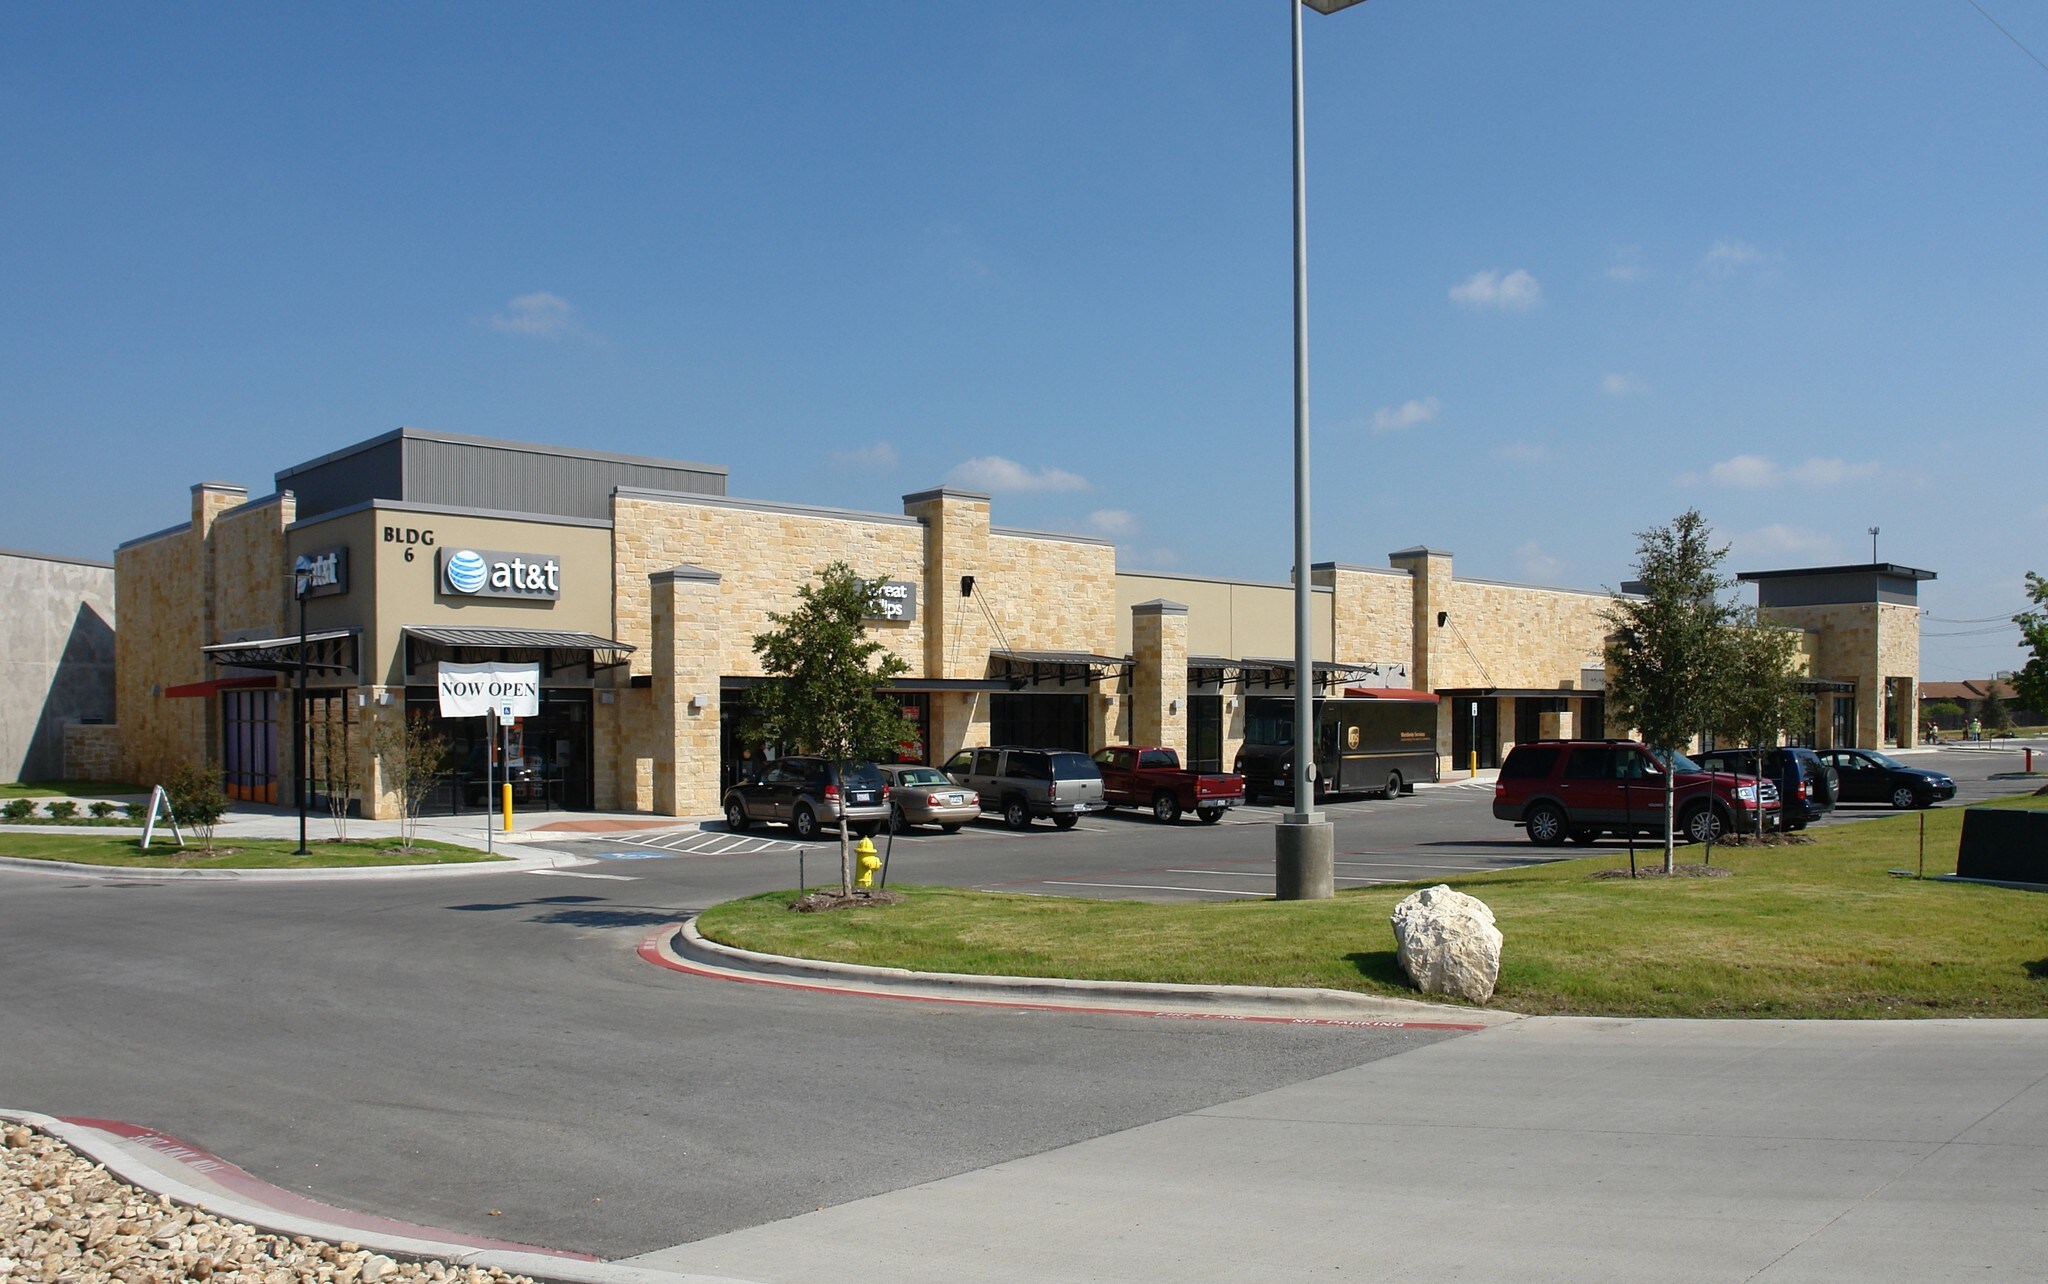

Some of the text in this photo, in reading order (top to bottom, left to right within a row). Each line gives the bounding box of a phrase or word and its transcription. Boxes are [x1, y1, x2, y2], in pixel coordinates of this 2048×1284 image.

[383, 526, 435, 546] BLDG
[404, 547, 415, 563] 6
[491, 557, 560, 592] at&t
[441, 681, 537, 697] NOW OPEN
[1326, 1020, 1405, 1028] PARKING
